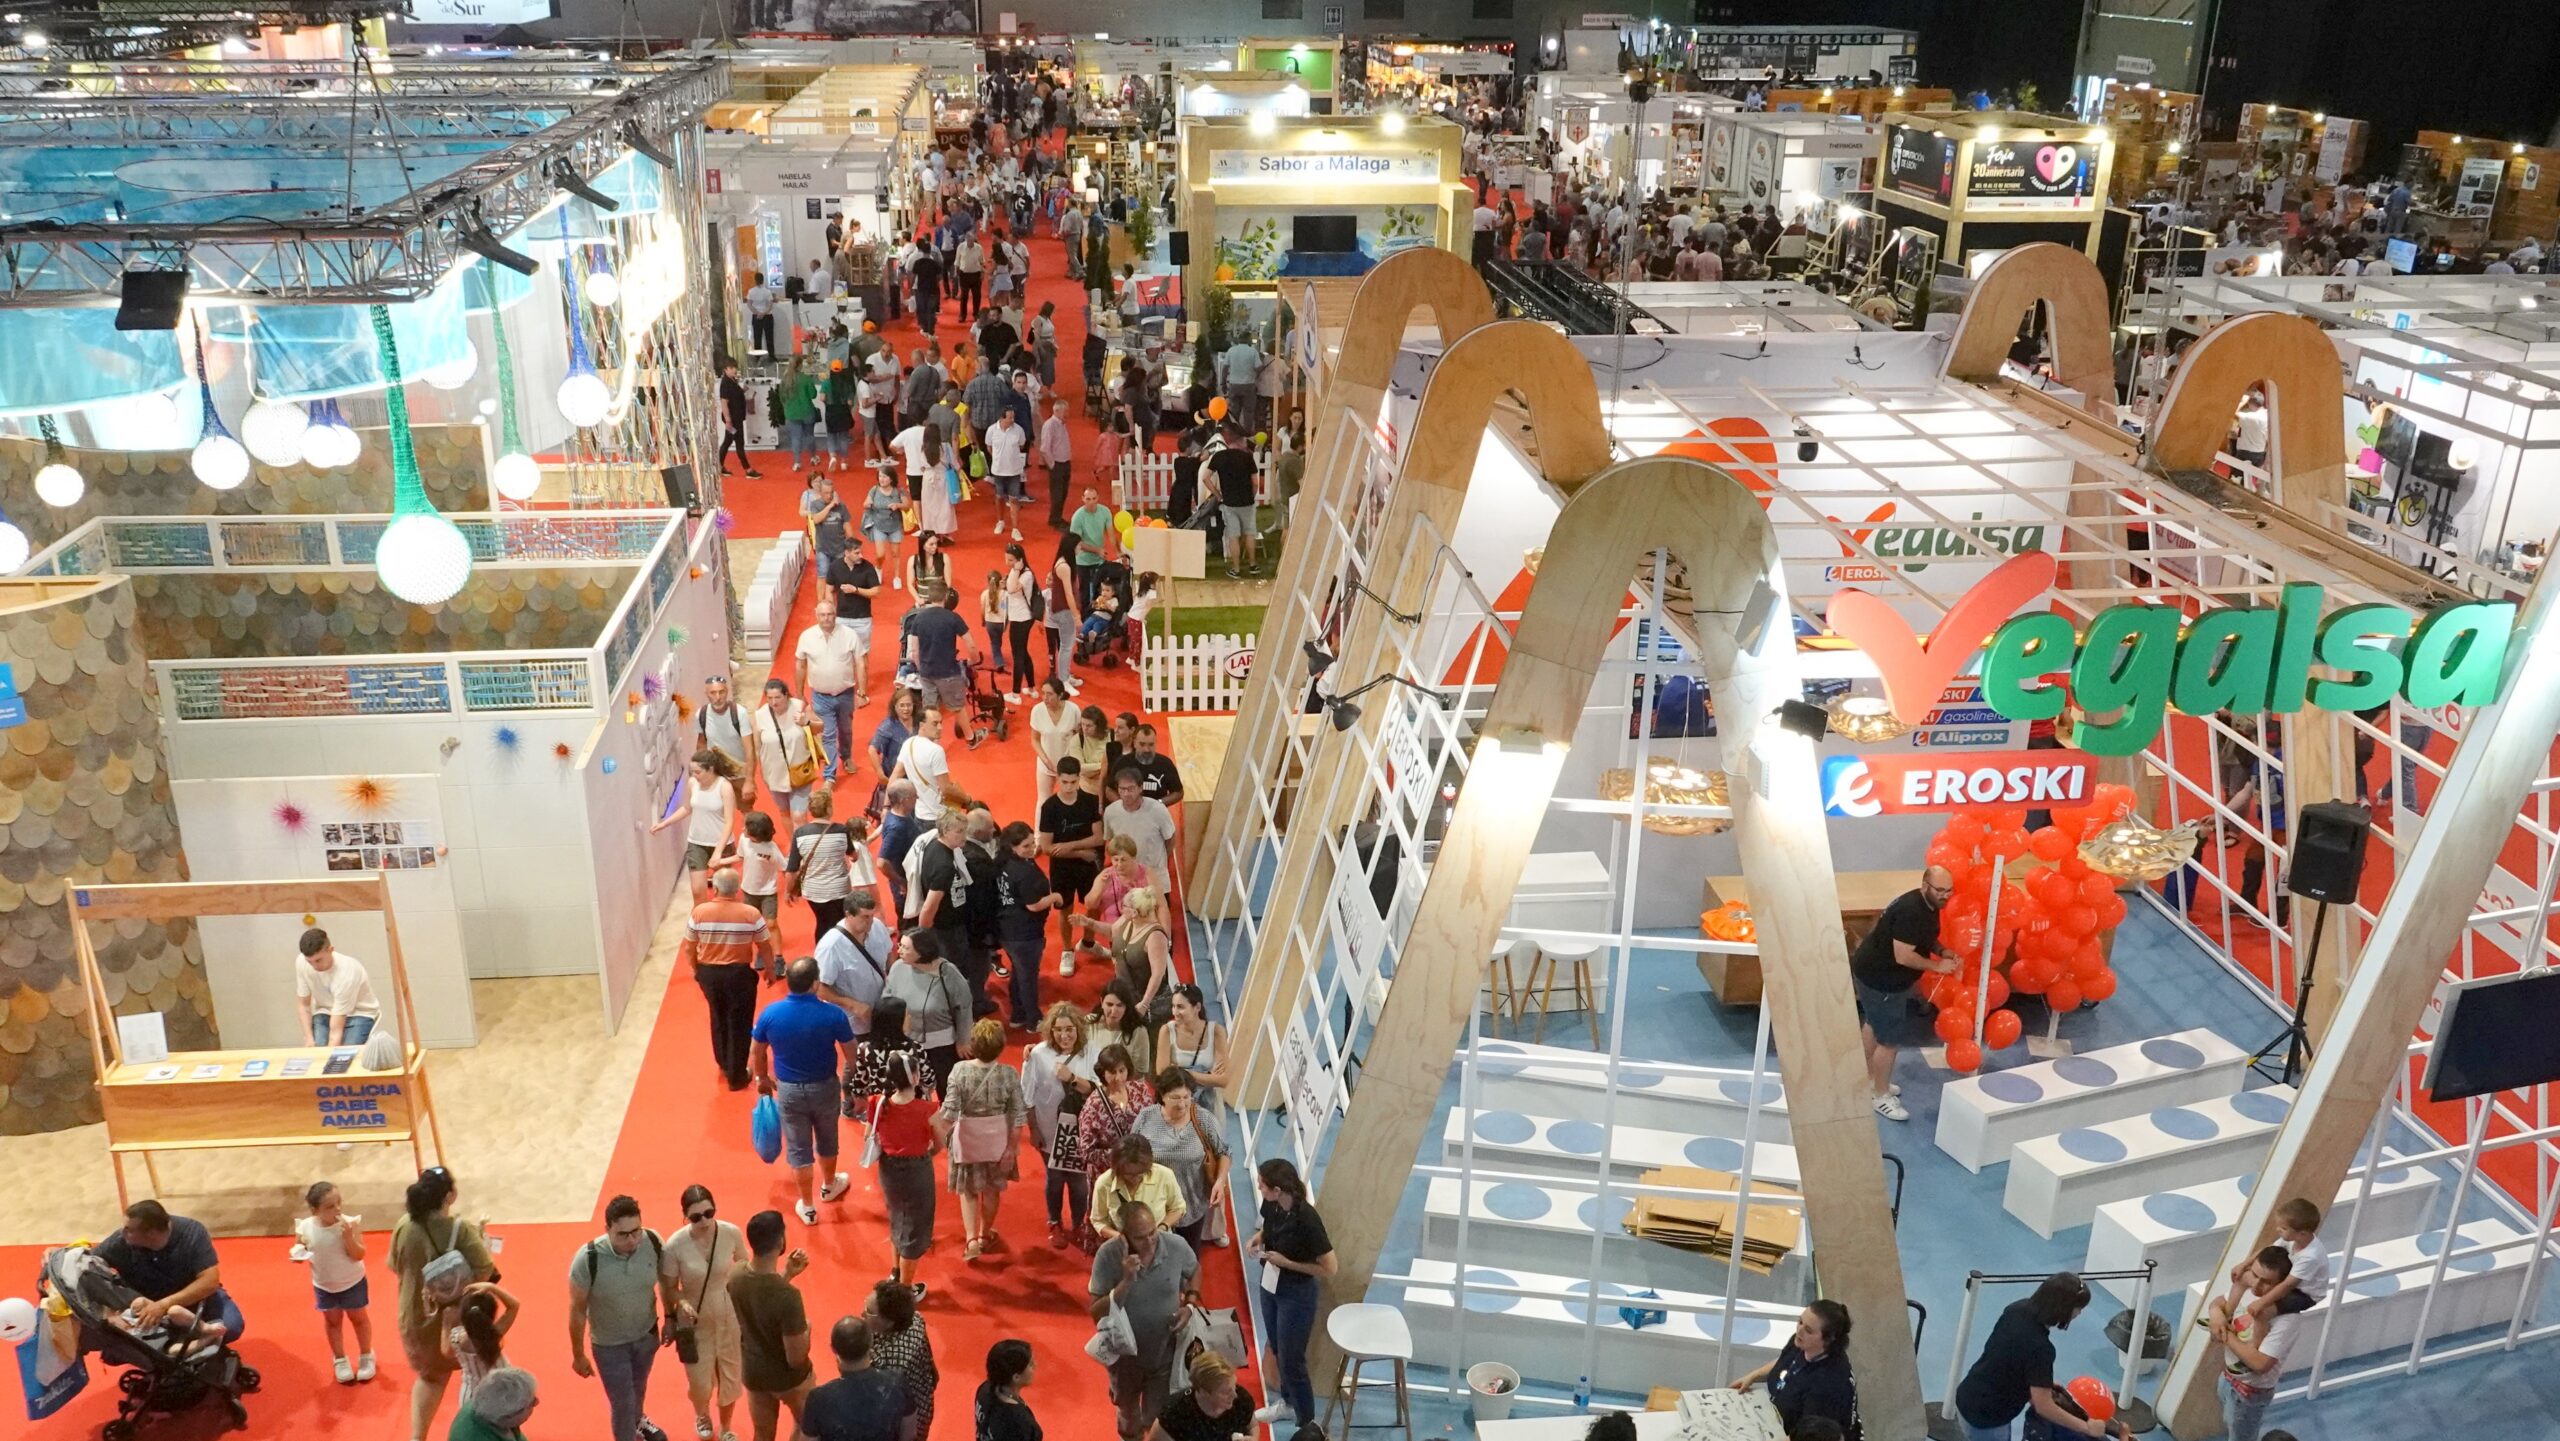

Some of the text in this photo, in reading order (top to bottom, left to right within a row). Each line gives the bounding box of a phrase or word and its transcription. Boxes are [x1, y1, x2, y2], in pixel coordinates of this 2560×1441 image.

[454, 0, 485, 16] Sur
[1259, 154, 1390, 173] Sabor a Málaga
[1987, 145, 2015, 166] Feria
[1826, 501, 2045, 573] Vegalsa
[1826, 549, 2516, 756] Vegalsa
[1936, 731, 2004, 744] Aliprox
[1902, 765, 2084, 805] EROSKI
[316, 1083, 402, 1098] GALICIA
[318, 1099, 378, 1113] SABE
[321, 1113, 387, 1127] AMAR
